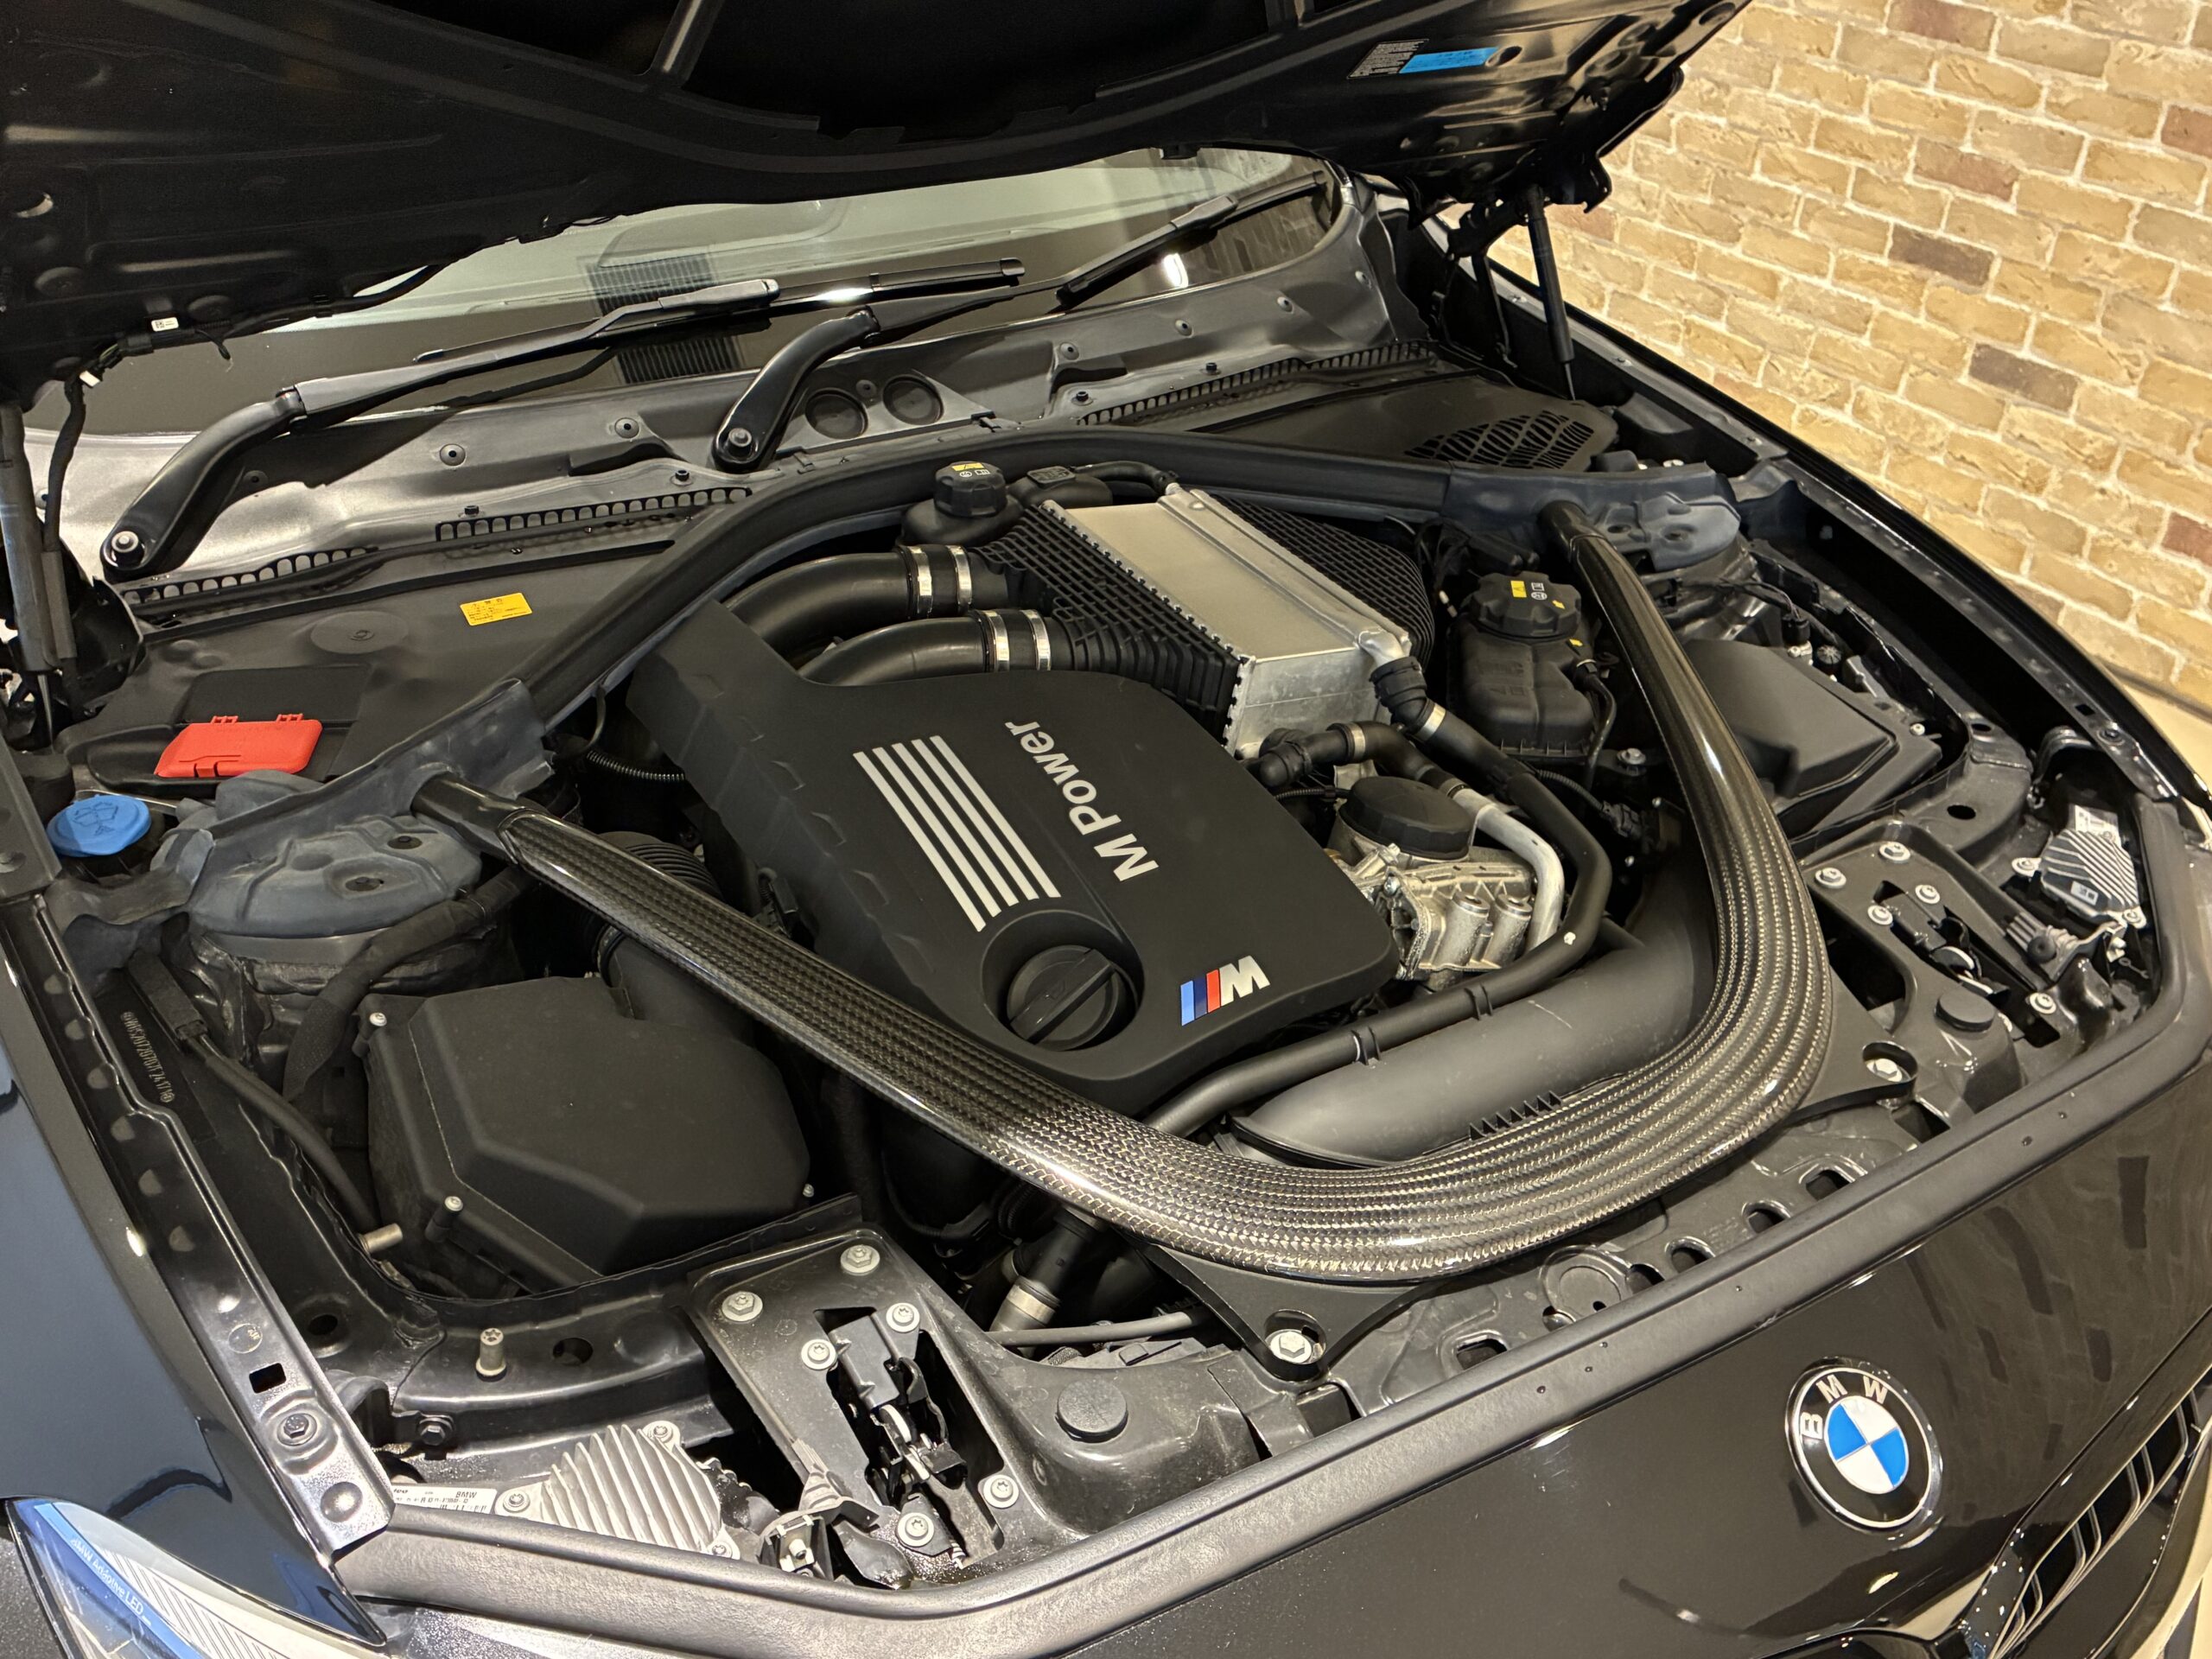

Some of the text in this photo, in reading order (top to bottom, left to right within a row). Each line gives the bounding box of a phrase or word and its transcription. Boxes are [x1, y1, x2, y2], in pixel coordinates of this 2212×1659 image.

[1005, 721, 1159, 882] M Power
[1800, 1374, 1889, 1440] BMW
[125, 1591, 144, 1615] LED
